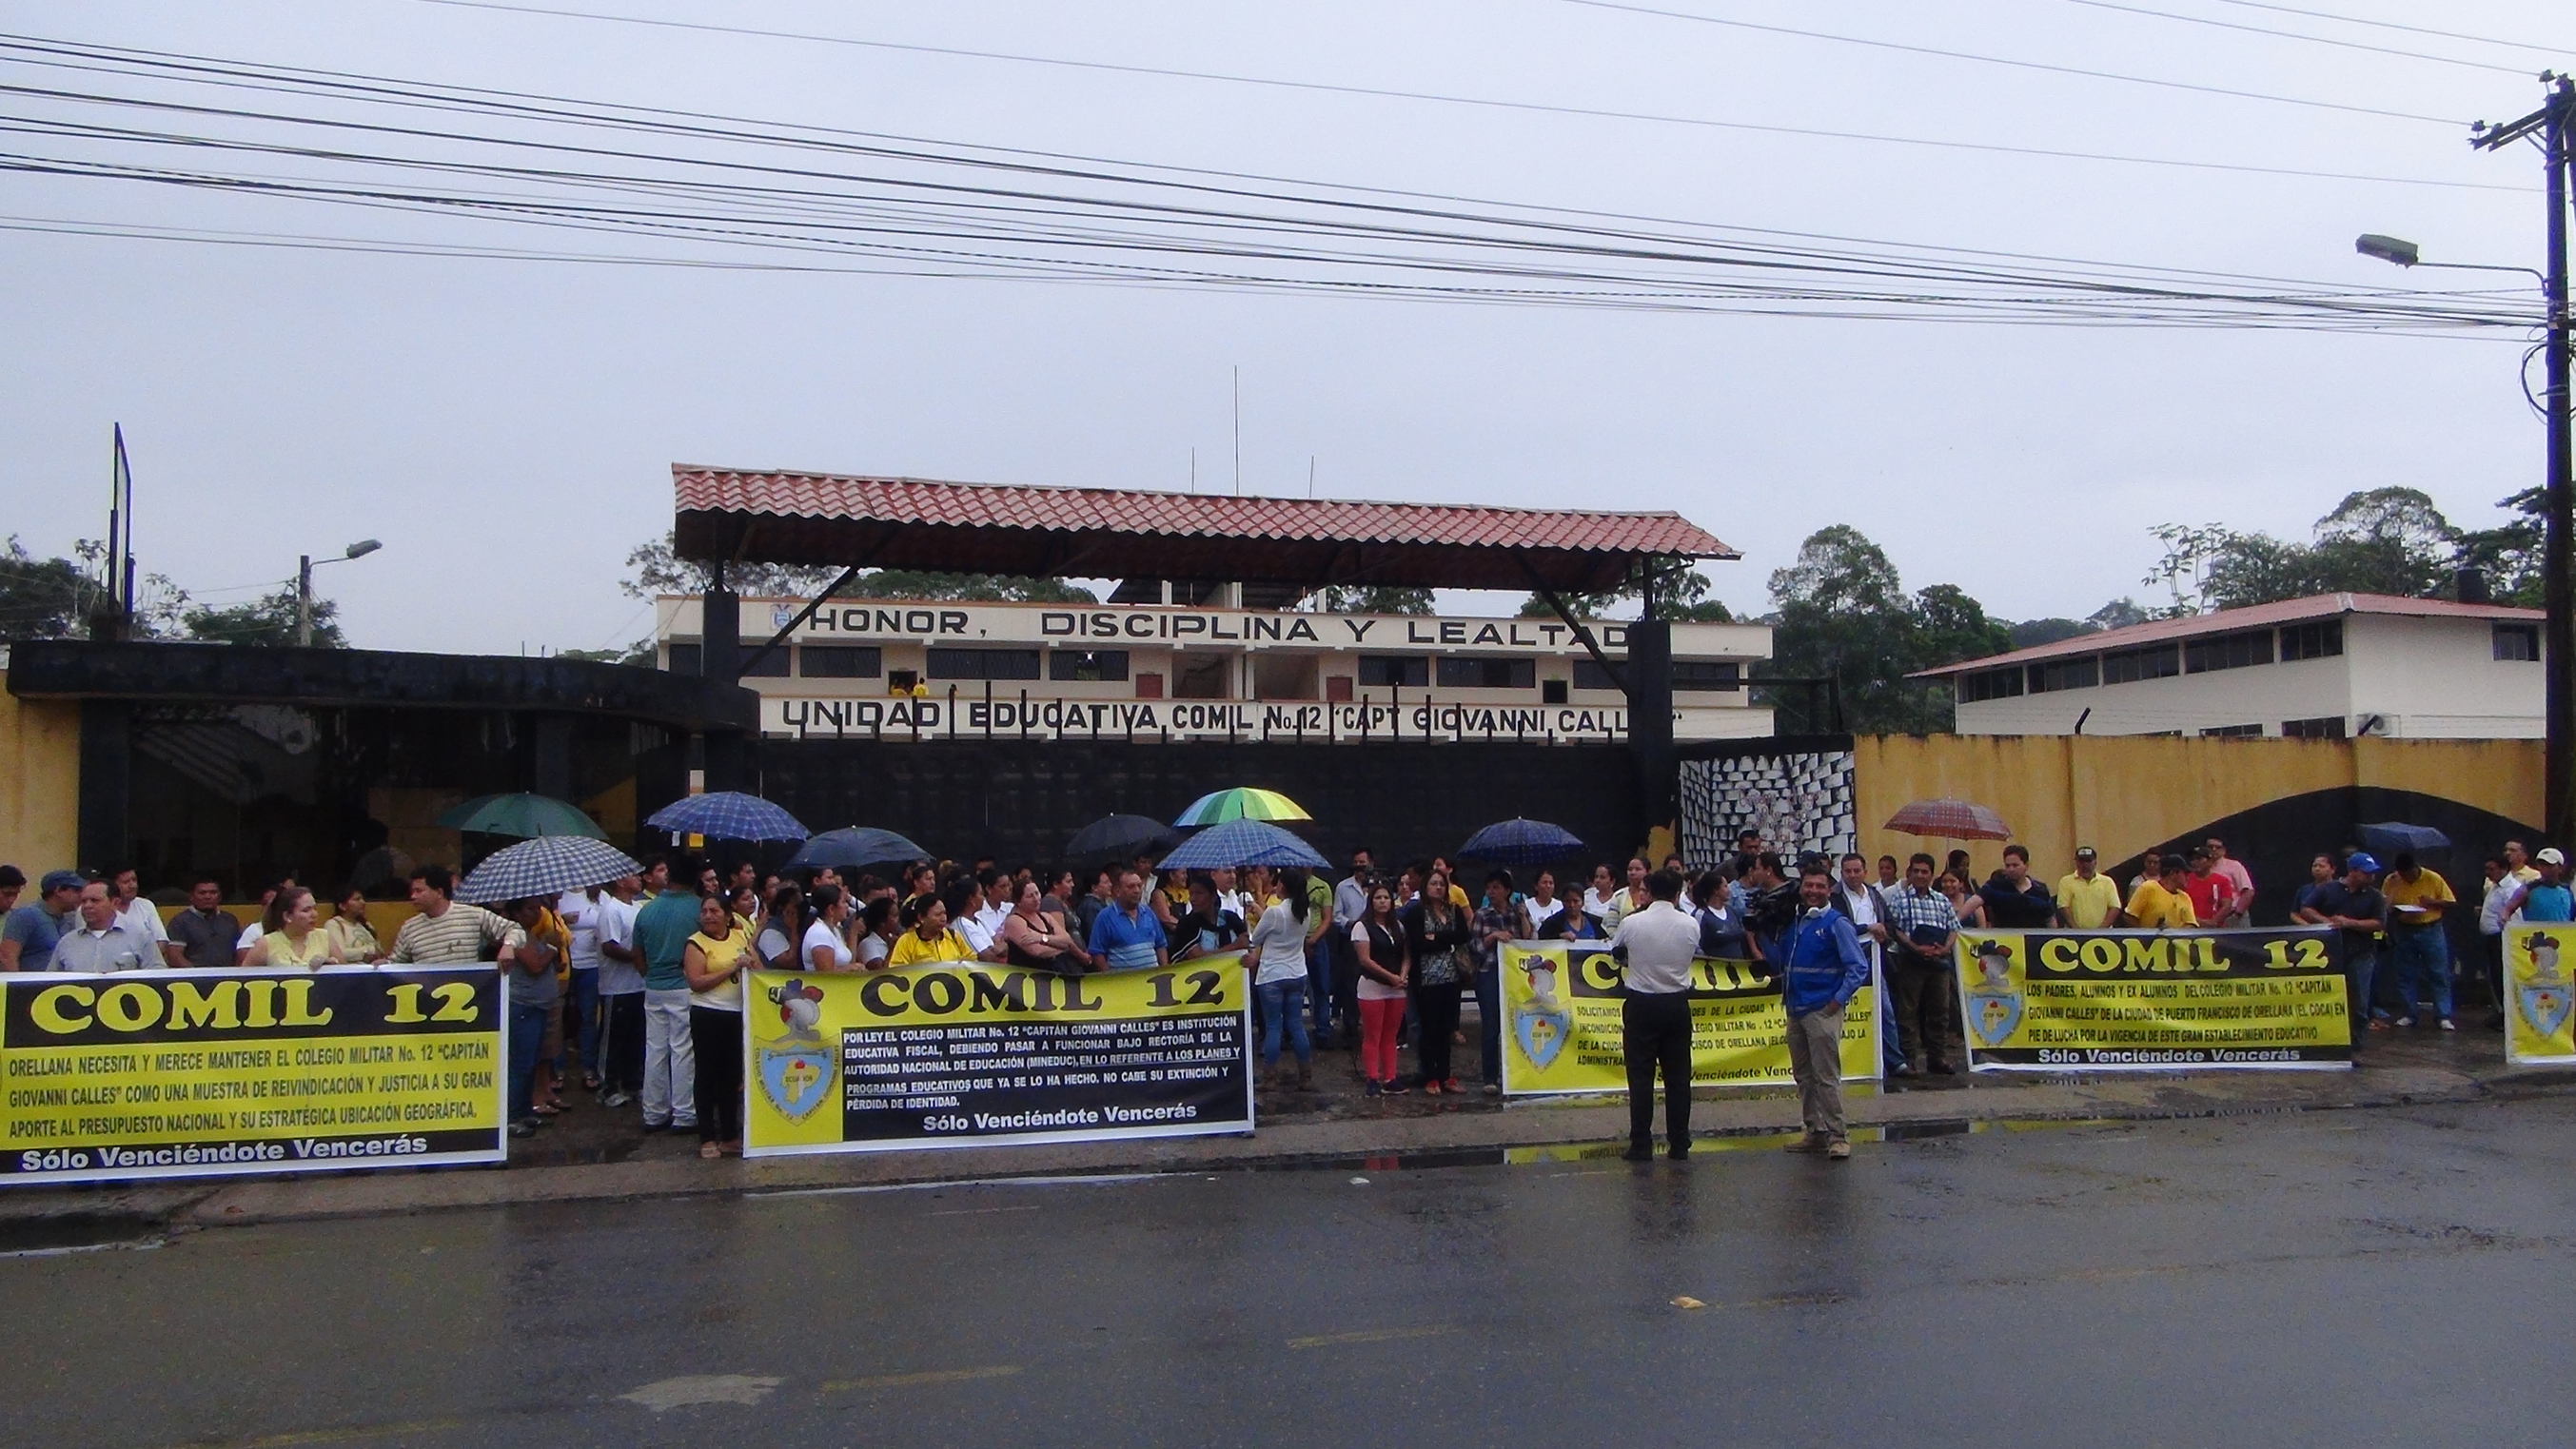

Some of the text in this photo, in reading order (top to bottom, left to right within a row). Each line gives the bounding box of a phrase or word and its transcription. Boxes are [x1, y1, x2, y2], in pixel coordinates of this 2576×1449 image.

[809, 609, 1629, 647] HONOR, DISCIPLINA Y LEALTAD
[783, 700, 940, 727] UNIDAD
[970, 702, 1157, 728] EDUCATIVA
[1172, 705, 1253, 729] COMIL
[1412, 708, 1545, 733] GIOVANNI
[2039, 938, 2329, 972] COMIL 12
[860, 969, 1225, 1016] COMIL 12
[2027, 985, 2041, 996] LOS
[2046, 985, 2076, 999] PADRES,
[2080, 986, 2115, 998] ALUMNOS
[2127, 986, 2136, 997] EX
[2140, 986, 2177, 997] ALUMNOS
[2185, 985, 2197, 997] DEL
[2201, 985, 2232, 997] COLEGIO
[2236, 983, 2265, 996] MILITAR
[2285, 982, 2293, 994] 12
[30, 980, 479, 1034] COMIL 12
[1577, 1007, 1621, 1017] SOLICITAMOS
[1711, 1006, 1720, 1015] DE
[1725, 1005, 1734, 1014] LA
[1740, 1004, 1764, 1014] CIUDAD
[2029, 1008, 2063, 1019] GIOVANNI
[2125, 1008, 2152, 1020] CIUDAD
[2166, 1008, 2195, 1020] PUERTO
[2197, 1007, 2240, 1019] FRANCISCO
[2242, 1006, 2252, 1018] DE
[2254, 1005, 2293, 1018] ORELLANA
[2335, 1003, 2345, 1015] EN
[843, 1032, 863, 1044] POR
[865, 1031, 884, 1043] LEY
[885, 1031, 897, 1042] EL
[901, 1029, 943, 1041] COLEGIO
[947, 1028, 986, 1039] MILITAR
[990, 1027, 1004, 1037] No.
[1008, 1026, 1019, 1036] 12
[1072, 1025, 1116, 1035] GIOVANNI
[1162, 1021, 1174, 1031] ES
[1177, 1015, 1237, 1029] INSTITUCIÓN
[1715, 1021, 1744, 1031] MILITAR
[1764, 1020, 1773, 1028] 12
[2029, 1027, 2317, 1042] PIE LUCHA POR LA VIGENCIA ESTE GRAN ESTABLECIMIENTO EDUCATIVO
[845, 1031, 1231, 1059] EDUCATIVA FISCAL, DEBIENDO PASAR A FUNCIONAR BAJO RECTORÍA DE LA
[1716, 1038, 1724, 1048] DE
[1728, 1035, 1766, 1048] ORELLANA
[2038, 1048, 2300, 1063] Sólo Venciéndote Vencerás
[10, 1058, 72, 1077] ORELLANA
[79, 1055, 136, 1074] NECESITA
[143, 1055, 149, 1071] Y
[156, 1053, 203, 1071] MERECE
[208, 1050, 271, 1069] MANTENER
[277, 1049, 289, 1067] EL
[296, 1048, 344, 1066] COLEGIO
[349, 1047, 393, 1064] MILITAR
[399, 1046, 415, 1062] No.
[421, 1045, 432, 1061] 12
[845, 1064, 899, 1076] AUTORIDAD
[902, 1061, 951, 1073] NACIONAL
[954, 1060, 966, 1070] DE
[969, 1055, 1024, 1070] EDUCACIÓN
[1080, 1054, 1092, 1066] EN
[1095, 1053, 1108, 1065] LO
[1111, 1051, 1164, 1064] REFERENTE
[1166, 1051, 1173, 1061] A
[1175, 1049, 1193, 1060] LOS
[1195, 1048, 1230, 1059] PLANES
[1233, 1048, 1240, 1057] Y
[10, 1089, 67, 1107] GIOVANNI
[126, 1086, 160, 1103] COMO
[165, 1085, 188, 1101] UNA
[193, 1082, 248, 1100] MUESTRA
[253, 1081, 268, 1098] DE
[271, 1074, 363, 1097] REIVINDICACIÓN
[367, 1076, 376, 1092] Y
[379, 1074, 428, 1091] JUSTICIA
[432, 1073, 438, 1089] A
[444, 1072, 458, 1089] SU
[462, 1071, 491, 1088] GRAN
[847, 1066, 1229, 1095] PROGRAMAS EDUCATIVOS QUE YA SE LO HA HECHO. NO CABE SU EXTINCIÓN Y
[847, 1095, 959, 1110] PÉRDIDA DE IDENTIDAD.
[923, 1102, 1197, 1131] Sólo Venciéndote Vencerás
[10, 1120, 56, 1138] APORTE
[61, 1119, 74, 1136] AL
[79, 1116, 163, 1135] PRESUPUESTO
[167, 1112, 225, 1132] NACIONAL
[229, 1111, 235, 1128] Y
[241, 1110, 255, 1128] SU
[260, 1106, 336, 1127] ESTRATÉGICA
[340, 1102, 401, 1124] UBICACIÓN
[22, 1134, 427, 1171] Sólo Venciéndote Vencerás
